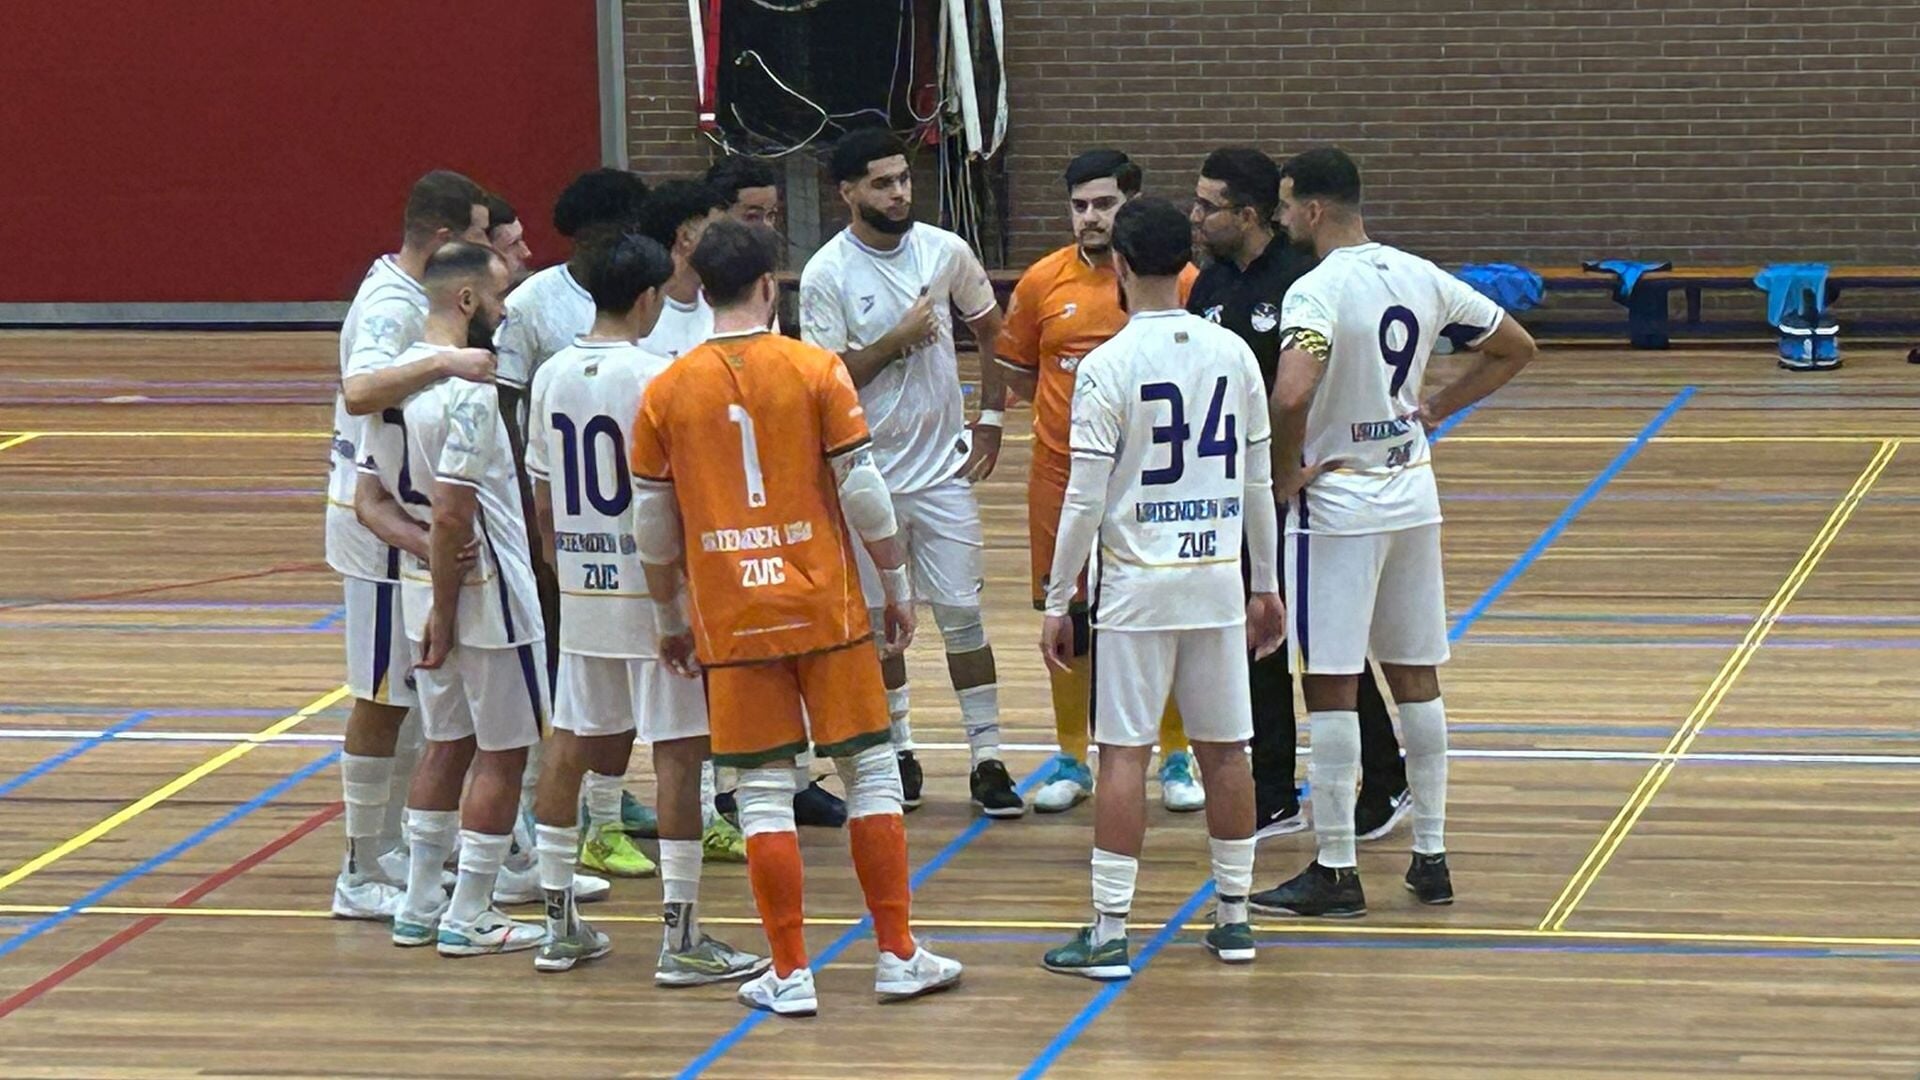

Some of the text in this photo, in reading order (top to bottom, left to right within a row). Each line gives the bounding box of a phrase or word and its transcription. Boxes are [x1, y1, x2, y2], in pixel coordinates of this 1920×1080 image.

[1379, 304, 1419, 398] 9
[551, 412, 633, 517] 10
[728, 403, 767, 508] 1
[1140, 375, 1238, 486] 34
